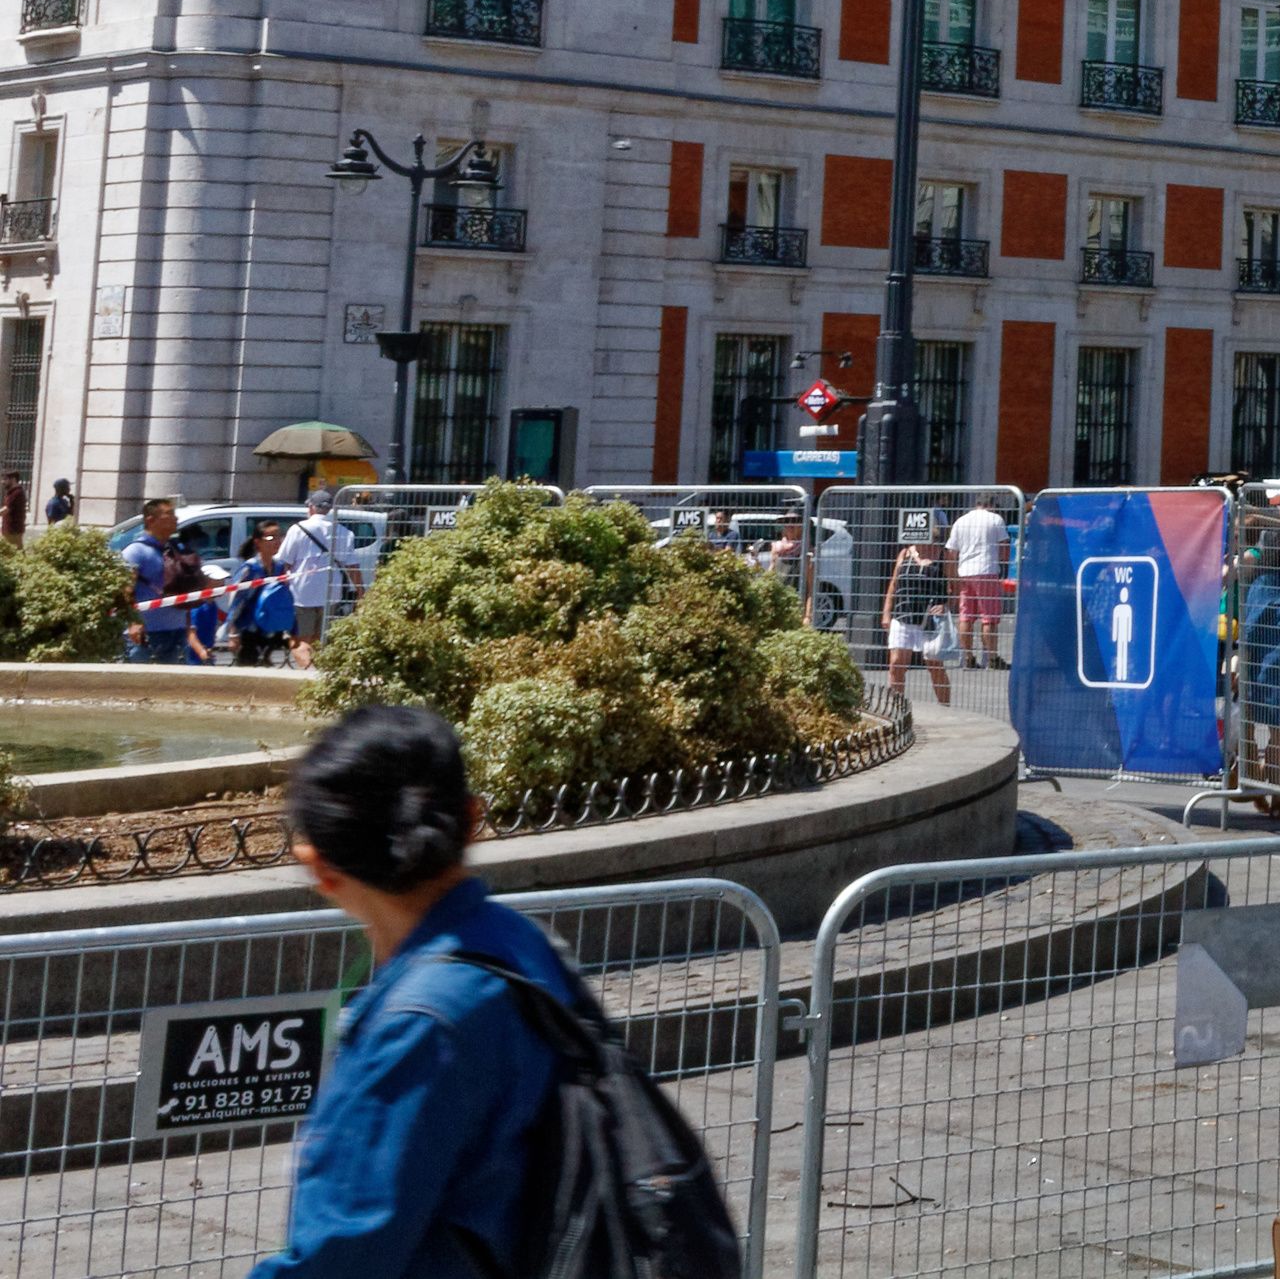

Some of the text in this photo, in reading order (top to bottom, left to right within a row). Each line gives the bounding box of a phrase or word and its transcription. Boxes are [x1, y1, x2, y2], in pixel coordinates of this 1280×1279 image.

[433, 510, 457, 525] AMS
[677, 510, 701, 525] AMS
[906, 512, 928, 528] AMS
[1114, 566, 1133, 584] WC
[188, 1018, 304, 1077] AMS
[172, 1070, 311, 1091] SOLUCIONES EN EVENTOS
[185, 1084, 312, 1111] 91 828 91 73
[170, 1102, 307, 1123] www.alquiler-ms.com
